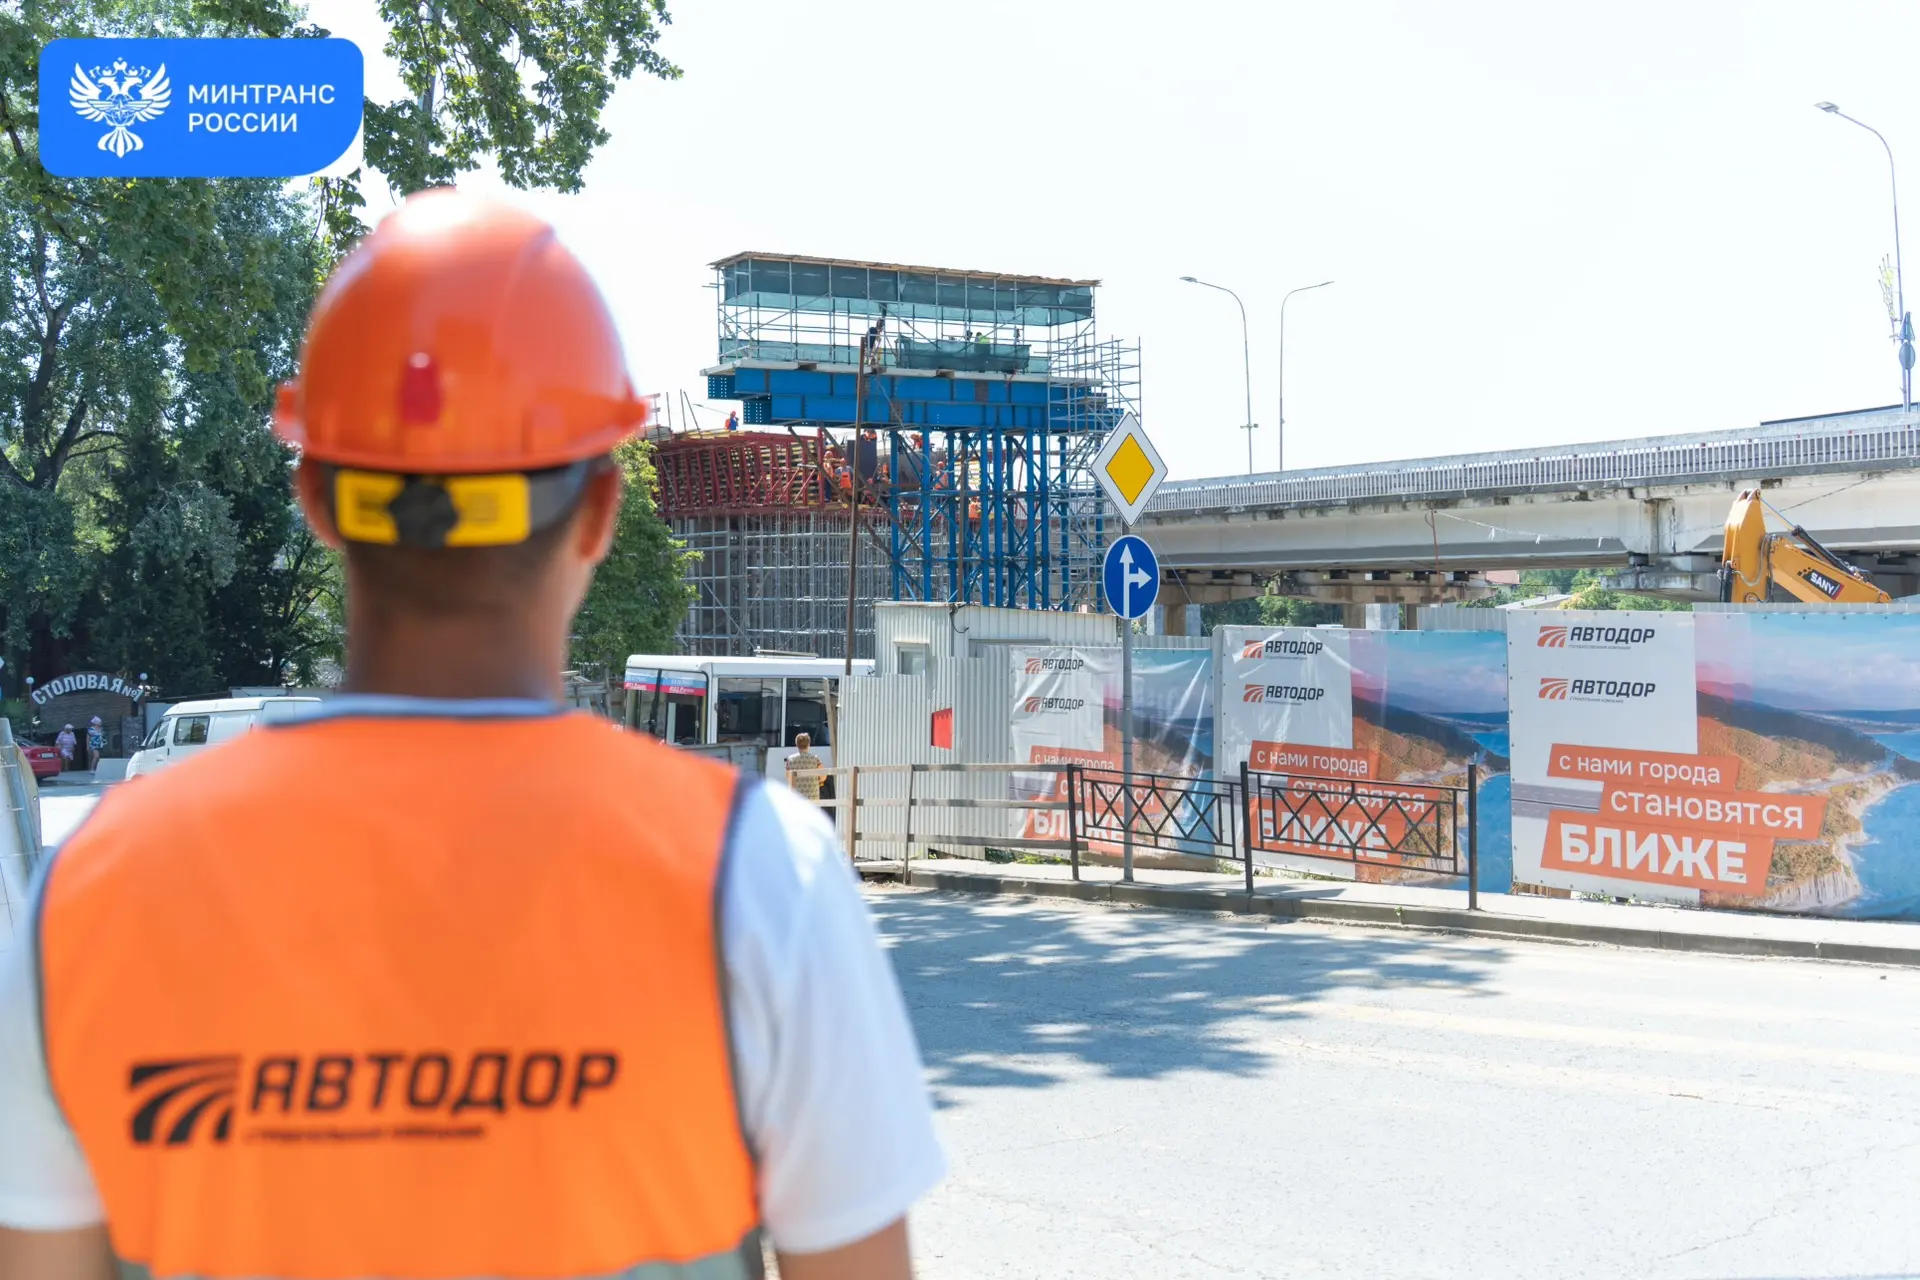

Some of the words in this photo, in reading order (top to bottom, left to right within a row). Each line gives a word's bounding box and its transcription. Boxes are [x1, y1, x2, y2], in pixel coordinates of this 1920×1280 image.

[1810, 571, 1835, 594] SANY
[1570, 626, 1655, 644] АВТОДОР
[1265, 640, 1323, 655] АВТОДОР
[1042, 658, 1084, 671] АВТОДОР
[31, 674, 124, 705] СТОЛОВАЯ
[1266, 685, 1324, 701] АВТОДОР
[1571, 679, 1656, 698] АВТОДОР
[1042, 697, 1084, 711] АВТОДОР
[1270, 752, 1308, 768] нами
[1313, 756, 1368, 775] города
[1559, 755, 1571, 771] с
[1577, 756, 1632, 776] нами
[1639, 762, 1721, 786] города
[1293, 779, 1425, 813] становятся
[1611, 790, 1803, 829] становятся
[1257, 808, 1388, 859] БЛИЖЕ
[1560, 823, 1747, 884] БЛИЖЕ
[249, 1051, 619, 1115] АВТОДОР
